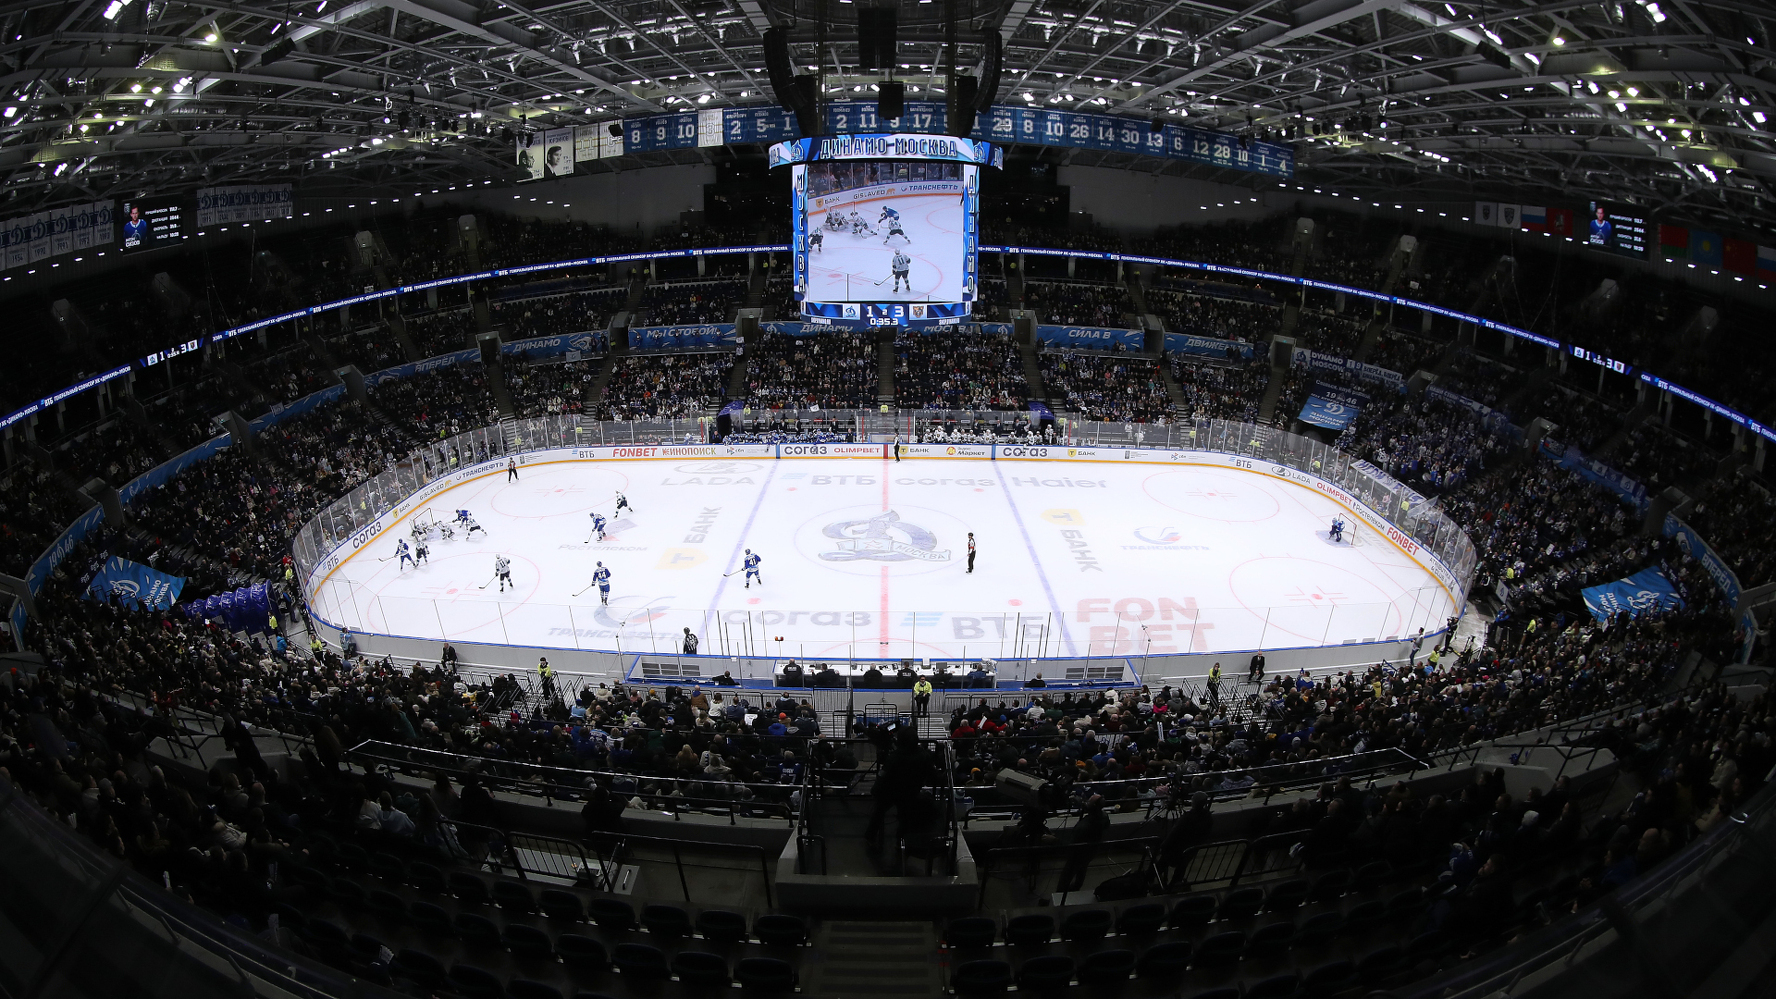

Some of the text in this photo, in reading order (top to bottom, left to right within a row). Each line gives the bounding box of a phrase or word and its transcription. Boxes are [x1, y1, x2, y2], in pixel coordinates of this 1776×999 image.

[730, 121, 741, 135] 2
[756, 119, 766, 133] 5
[836, 115, 847, 129] 2
[859, 114, 877, 128] 11
[913, 114, 931, 128] 17
[1023, 119, 1034, 134] 8
[656, 127, 666, 141] 9
[677, 124, 695, 139] 10
[1045, 122, 1064, 137] 10
[1070, 124, 1090, 139] 26
[1097, 127, 1115, 142] 14
[631, 130, 641, 144] 8
[1121, 130, 1140, 144] 30
[1146, 133, 1163, 147] 13
[1174, 137, 1183, 150] 6
[1193, 140, 1209, 156] 12
[1214, 144, 1231, 159] 28
[1237, 150, 1248, 163] 10
[1260, 155, 1266, 167] 1
[1280, 160, 1287, 172] 4
[853, 189, 885, 199] GISLAVED
[796, 174, 805, 293] МОСКВА
[967, 175, 976, 293] ДИНАМО
[866, 306, 874, 318] 1
[894, 306, 904, 318] 3
[870, 318, 899, 326] 0:35.3
[1068, 329, 1111, 340] СИЛА В
[159, 351, 165, 361] 1
[180, 343, 187, 354] 3
[513, 339, 561, 353] ДИНАМО
[1311, 351, 1344, 365] DYNAMO
[1585, 351, 1591, 361] 1
[1606, 359, 1613, 369] 3
[1311, 359, 1345, 373] MOSCOW
[1325, 391, 1337, 399] 19
[579, 450, 595, 459] ВТБ
[613, 447, 658, 457] FONBET
[462, 462, 504, 478] ТРАНСНЕФТЬ
[1236, 459, 1252, 469] ВТБ
[660, 476, 755, 486] LADA
[811, 475, 877, 486] ВТБ
[1013, 476, 1107, 489] Haier
[1292, 472, 1311, 485] LADA
[1316, 482, 1352, 506] OLIMPBET
[683, 506, 723, 544] БАНК
[1386, 526, 1419, 556] FONBET
[49, 534, 74, 572] 19 46
[895, 542, 946, 561] МОСКВА
[1060, 529, 1103, 573] БАНК
[327, 554, 340, 572] ВТБ
[1702, 553, 1732, 593] ВПЕРЁД
[1076, 597, 1201, 623] FON
[952, 616, 1046, 640] ВТБ
[1088, 622, 1215, 655] BET
